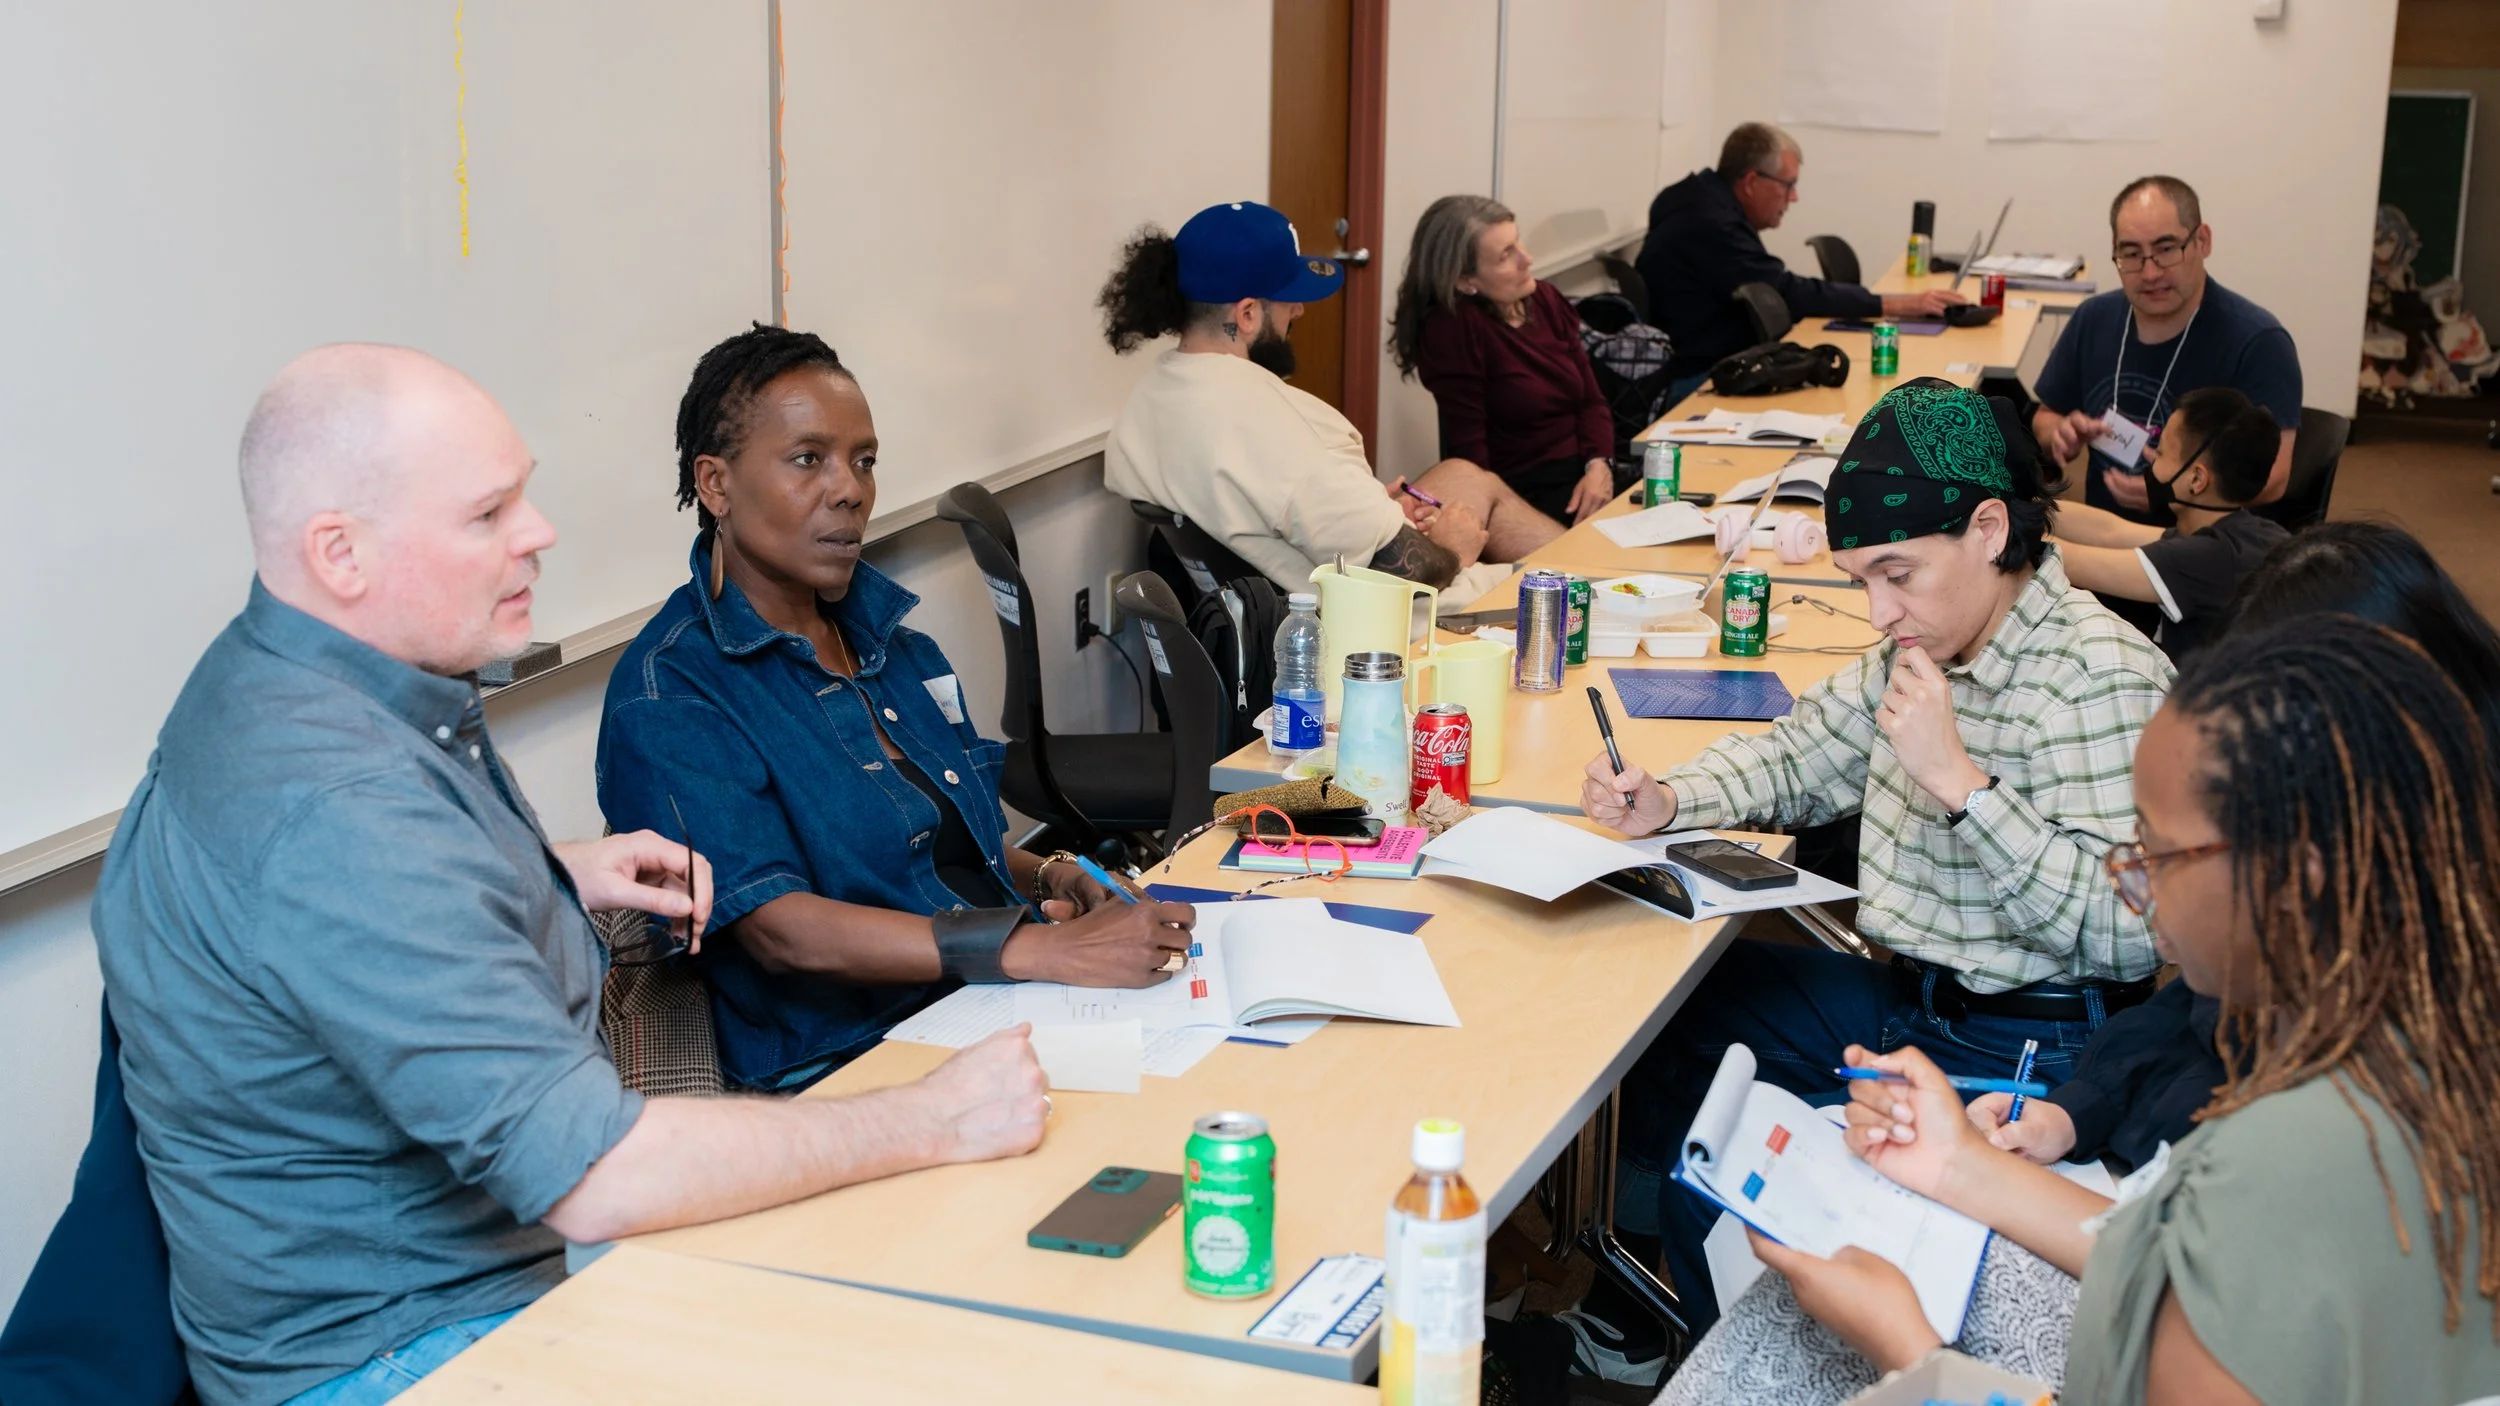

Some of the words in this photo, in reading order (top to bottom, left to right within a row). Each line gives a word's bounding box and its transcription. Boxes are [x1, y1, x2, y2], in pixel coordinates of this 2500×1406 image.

[1727, 607, 1760, 617] CANADA
[1567, 615, 1583, 623] ADA
[1733, 614, 1751, 623] DRY
[1724, 631, 1747, 640] GINGER
[1301, 714, 1326, 728] esk
[1413, 722, 1471, 756] ca-Cola
[1417, 760, 1436, 769] TASTE
[1385, 800, 1408, 813] S'well
[1375, 829, 1400, 860] AGREEMENTS
[1389, 830, 1416, 860] COLLECTIVE
